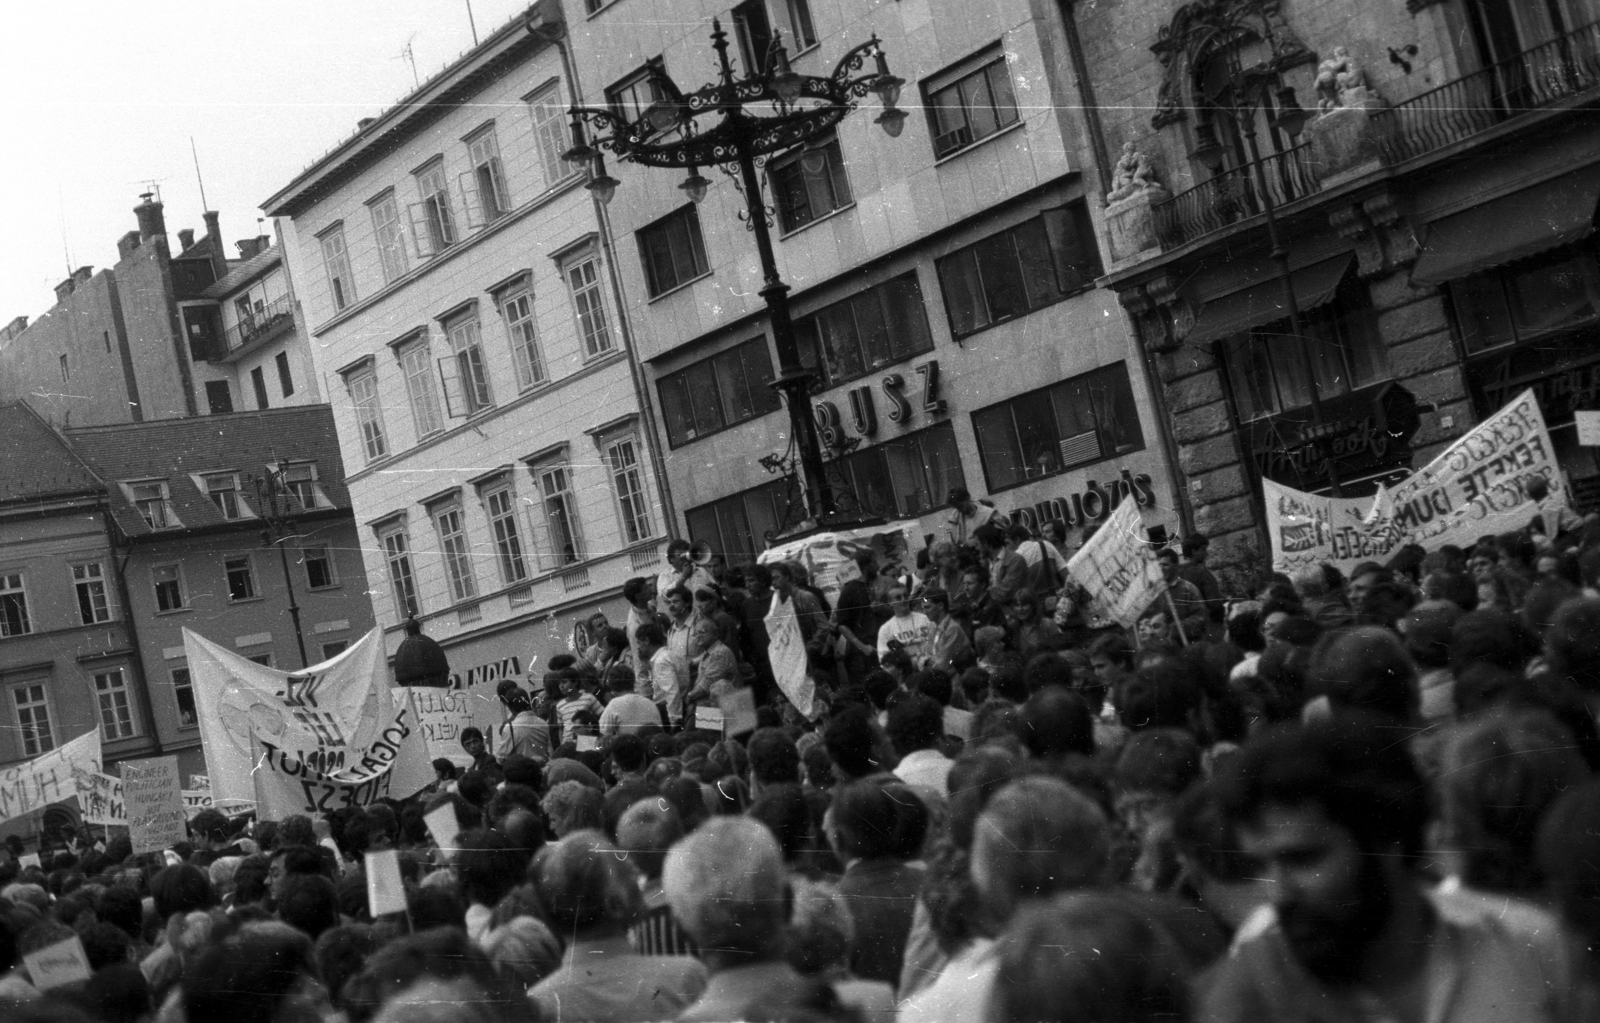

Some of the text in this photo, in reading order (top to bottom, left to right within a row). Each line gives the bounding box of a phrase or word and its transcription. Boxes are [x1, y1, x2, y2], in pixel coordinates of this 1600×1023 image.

[463, 656, 521, 690] INDIA
[125, 766, 169, 781] ENGINEER
[125, 778, 173, 793] POLITICIAN
[134, 790, 174, 804] HUNGARY
